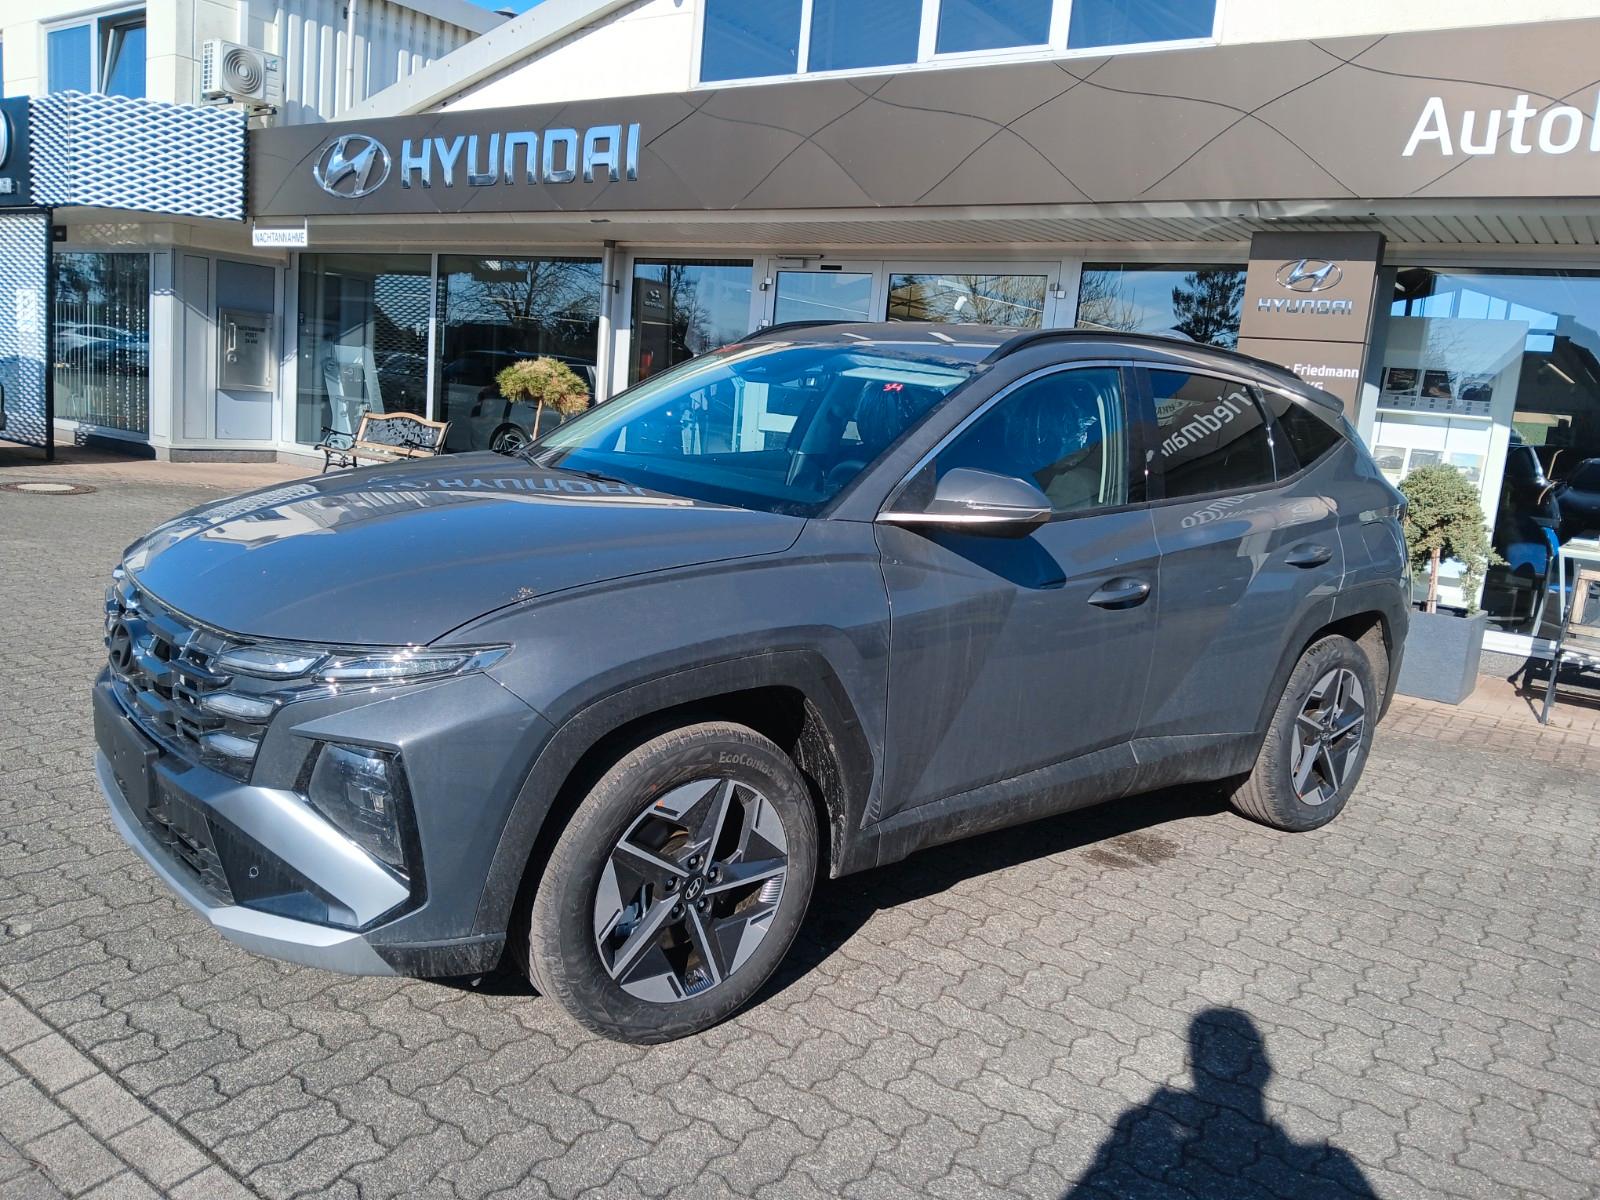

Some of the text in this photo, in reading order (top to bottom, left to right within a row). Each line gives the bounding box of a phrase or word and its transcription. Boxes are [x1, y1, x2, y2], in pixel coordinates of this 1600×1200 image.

[1401, 90, 1600, 157] Auto
[401, 122, 641, 189] HYUNDAI
[254, 231, 305, 244] NACHTANNAHME
[1257, 297, 1353, 316] HYUNDAI
[1293, 363, 1360, 379] Friedmann
